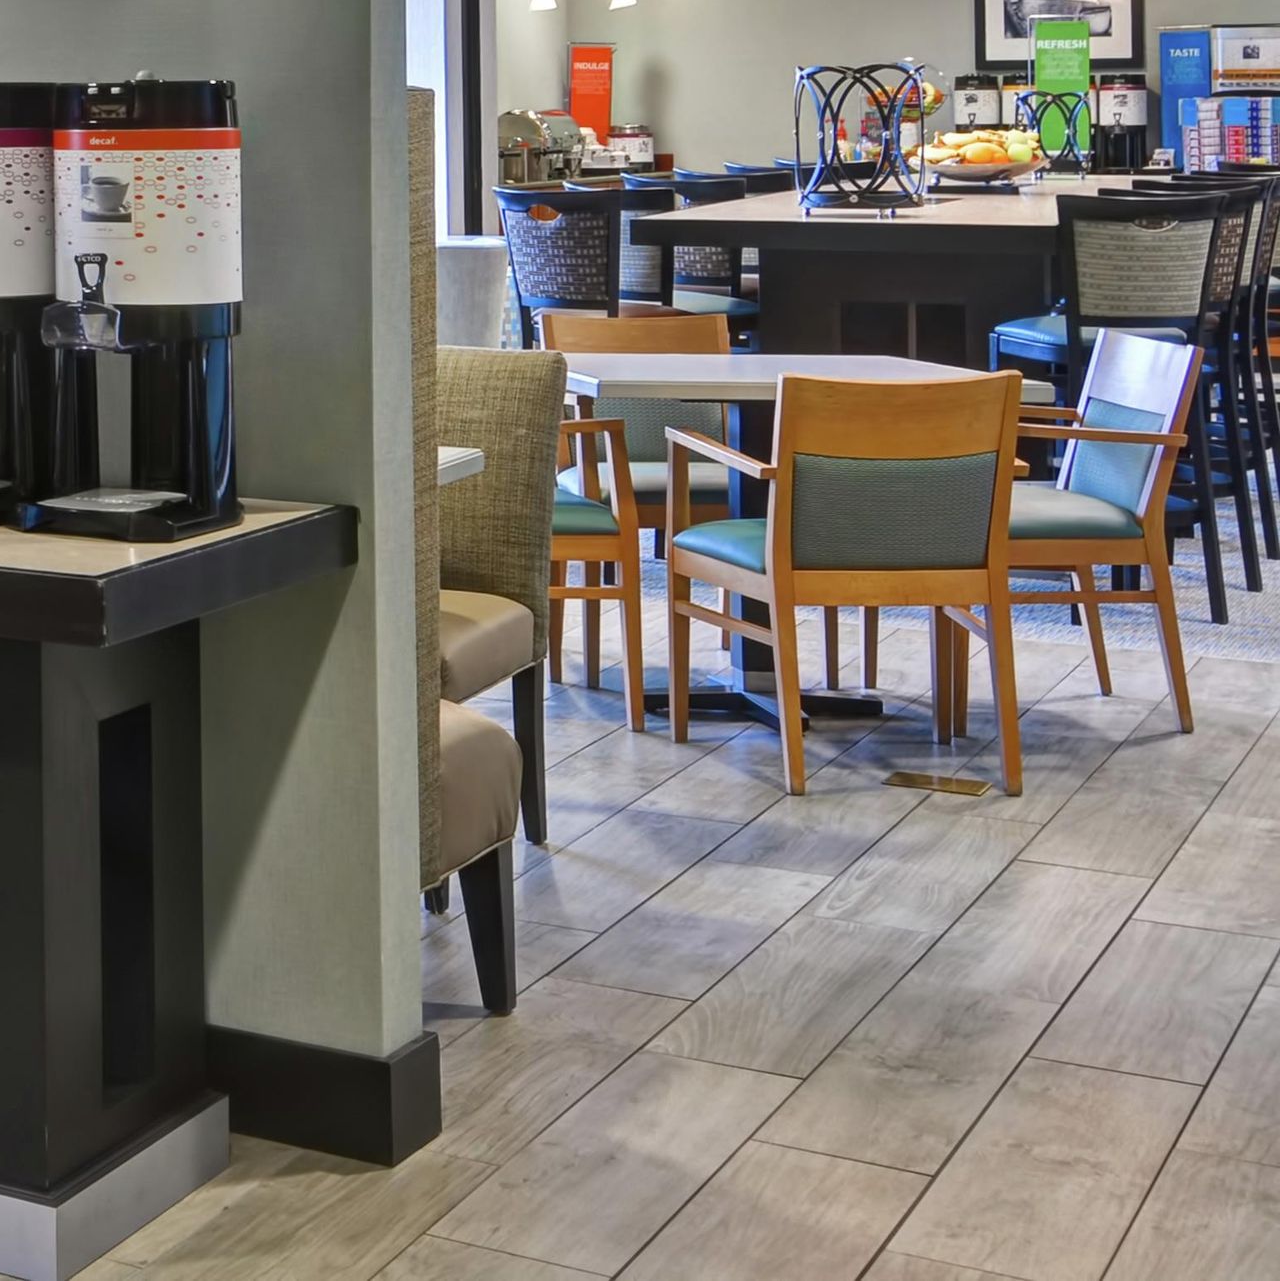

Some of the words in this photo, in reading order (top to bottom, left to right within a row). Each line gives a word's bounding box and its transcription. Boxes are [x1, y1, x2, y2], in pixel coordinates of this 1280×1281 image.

[1036, 39, 1088, 50] REFRESH
[1168, 47, 1201, 58] TASTE
[573, 61, 610, 70] INDULGE
[90, 136, 119, 145] decaf.
